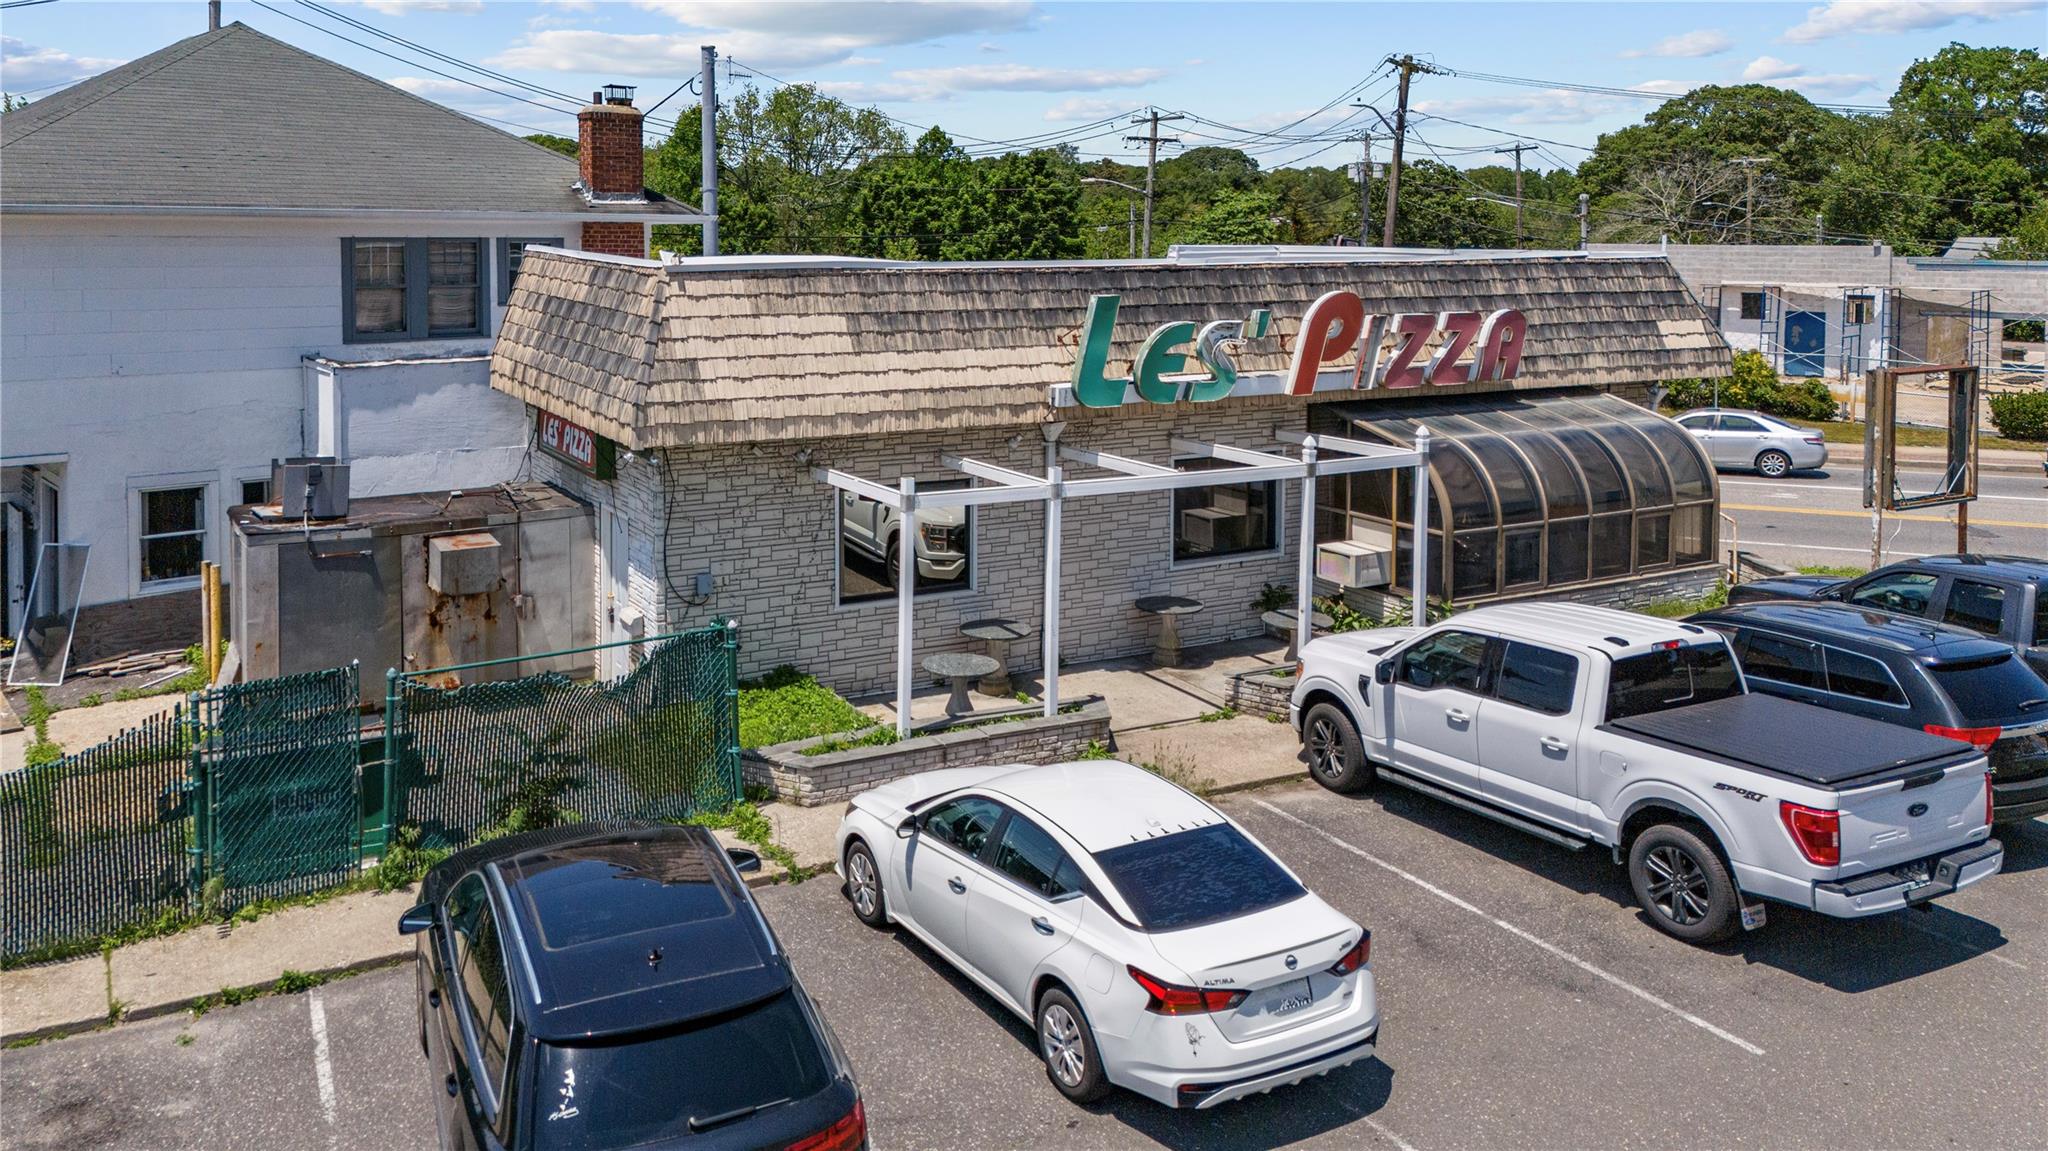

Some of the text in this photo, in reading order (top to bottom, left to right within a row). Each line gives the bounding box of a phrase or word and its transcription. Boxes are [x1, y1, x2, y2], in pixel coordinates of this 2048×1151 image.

[1284, 290, 1527, 396] PIZZA
[542, 414, 592, 464] LES' PIZZA
[1712, 782, 1768, 802] SPORT
[1204, 977, 1235, 986] ALTIMA
